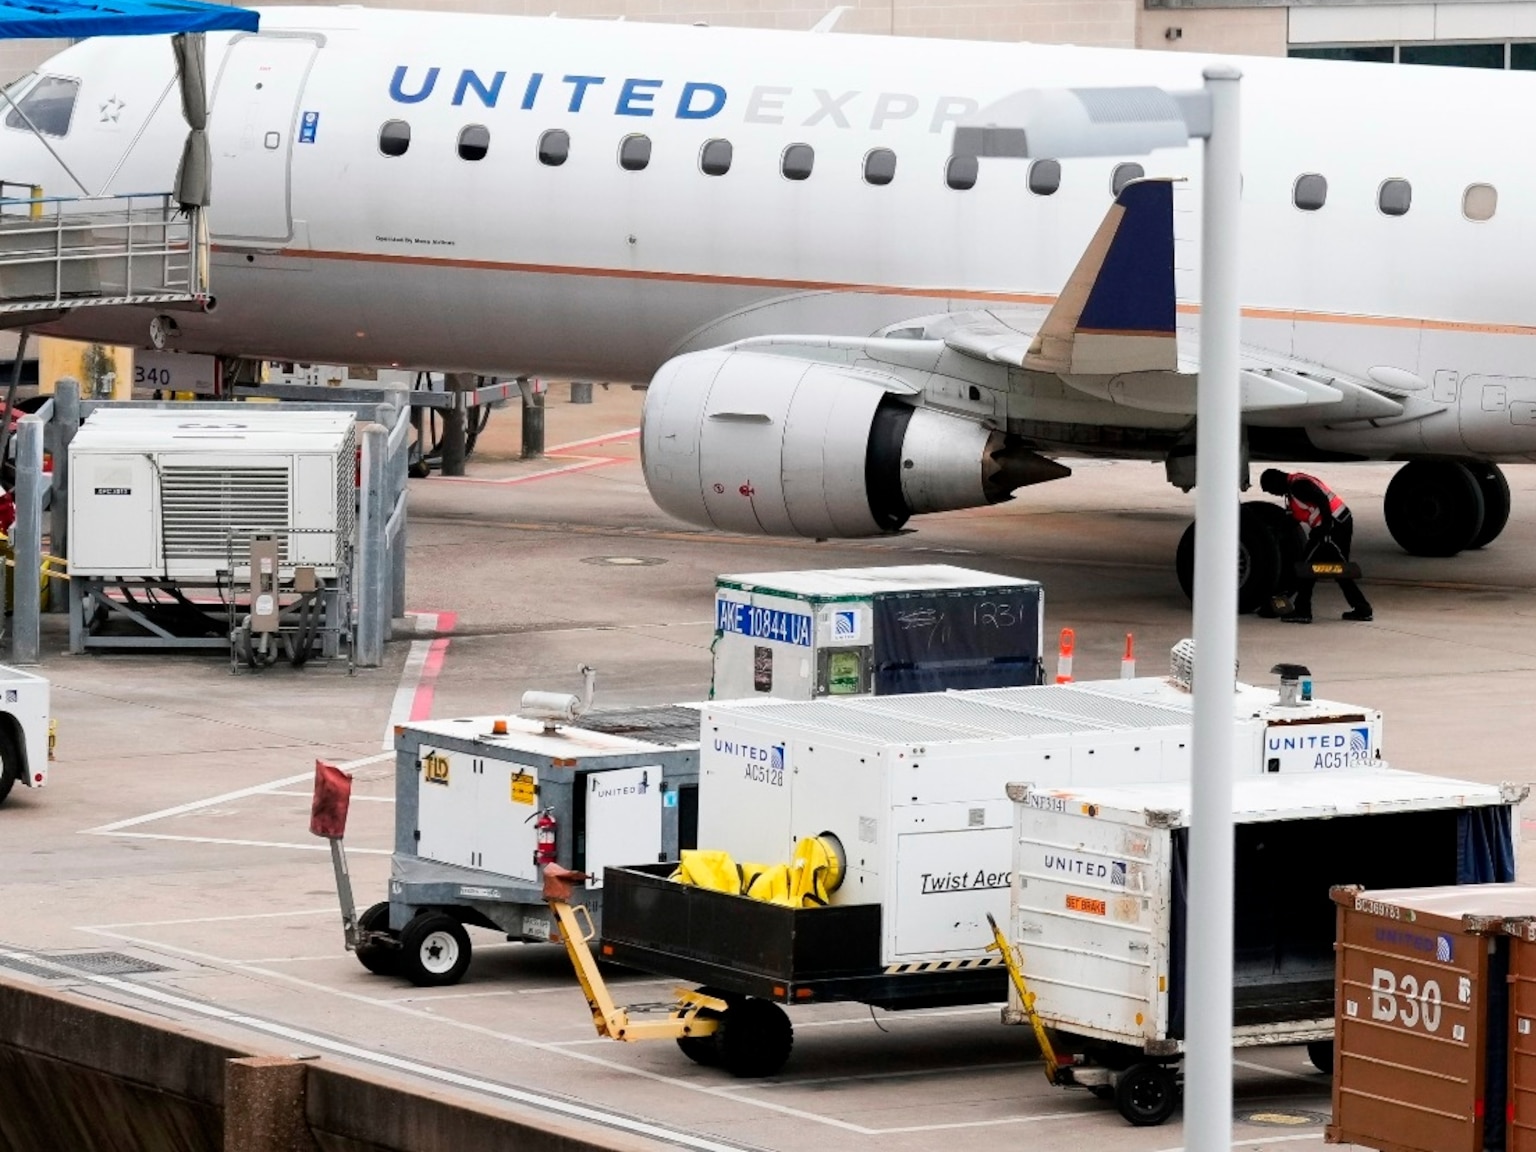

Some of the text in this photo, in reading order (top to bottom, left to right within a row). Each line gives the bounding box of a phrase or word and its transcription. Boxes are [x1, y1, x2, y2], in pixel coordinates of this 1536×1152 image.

[389, 65, 980, 134] UNITED EXPR
[134, 365, 171, 386] 340
[720, 601, 810, 646] AKE 10844 UA
[714, 738, 768, 762] UNITED
[1269, 735, 1346, 751] UNITED
[744, 764, 784, 787] AC5128
[598, 786, 636, 798] UNITED
[1044, 854, 1107, 878] UNITED
[921, 872, 969, 892] Twist
[1065, 895, 1106, 916] SET BRAKE
[1374, 927, 1434, 952] UNITED
[1371, 967, 1442, 1032] B30
